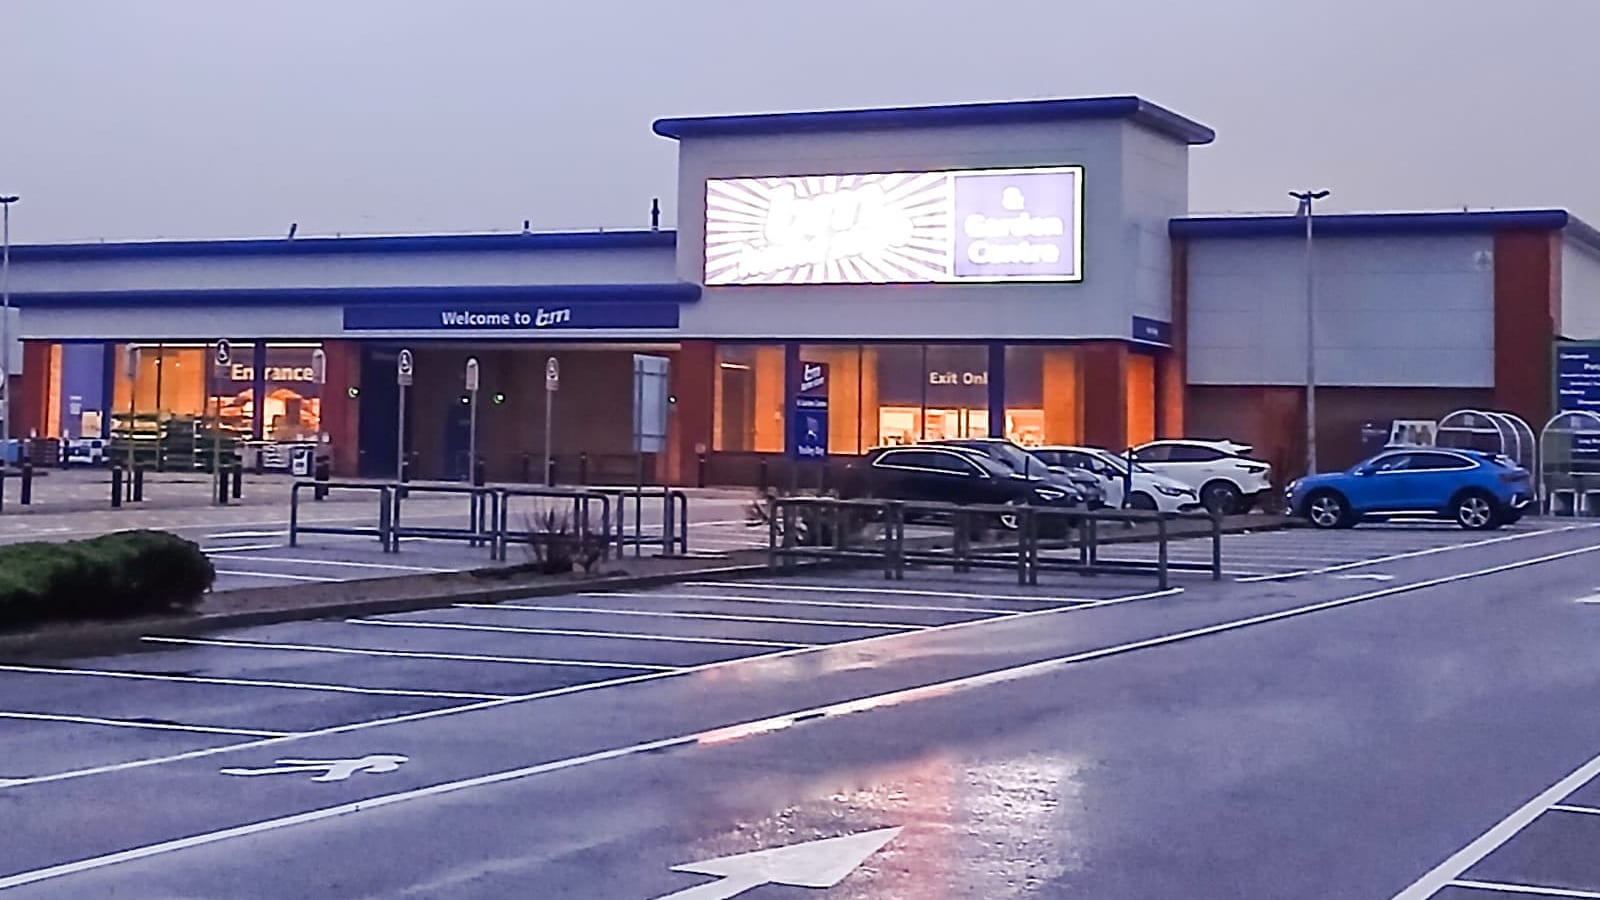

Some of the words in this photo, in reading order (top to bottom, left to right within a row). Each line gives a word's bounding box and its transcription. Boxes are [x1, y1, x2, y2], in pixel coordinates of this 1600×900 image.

[441, 310, 511, 326] Welcome
[514, 311, 532, 326] to
[231, 363, 314, 381] Enrance
[930, 371, 958, 385] Exit
[963, 371, 989, 385] Onl
